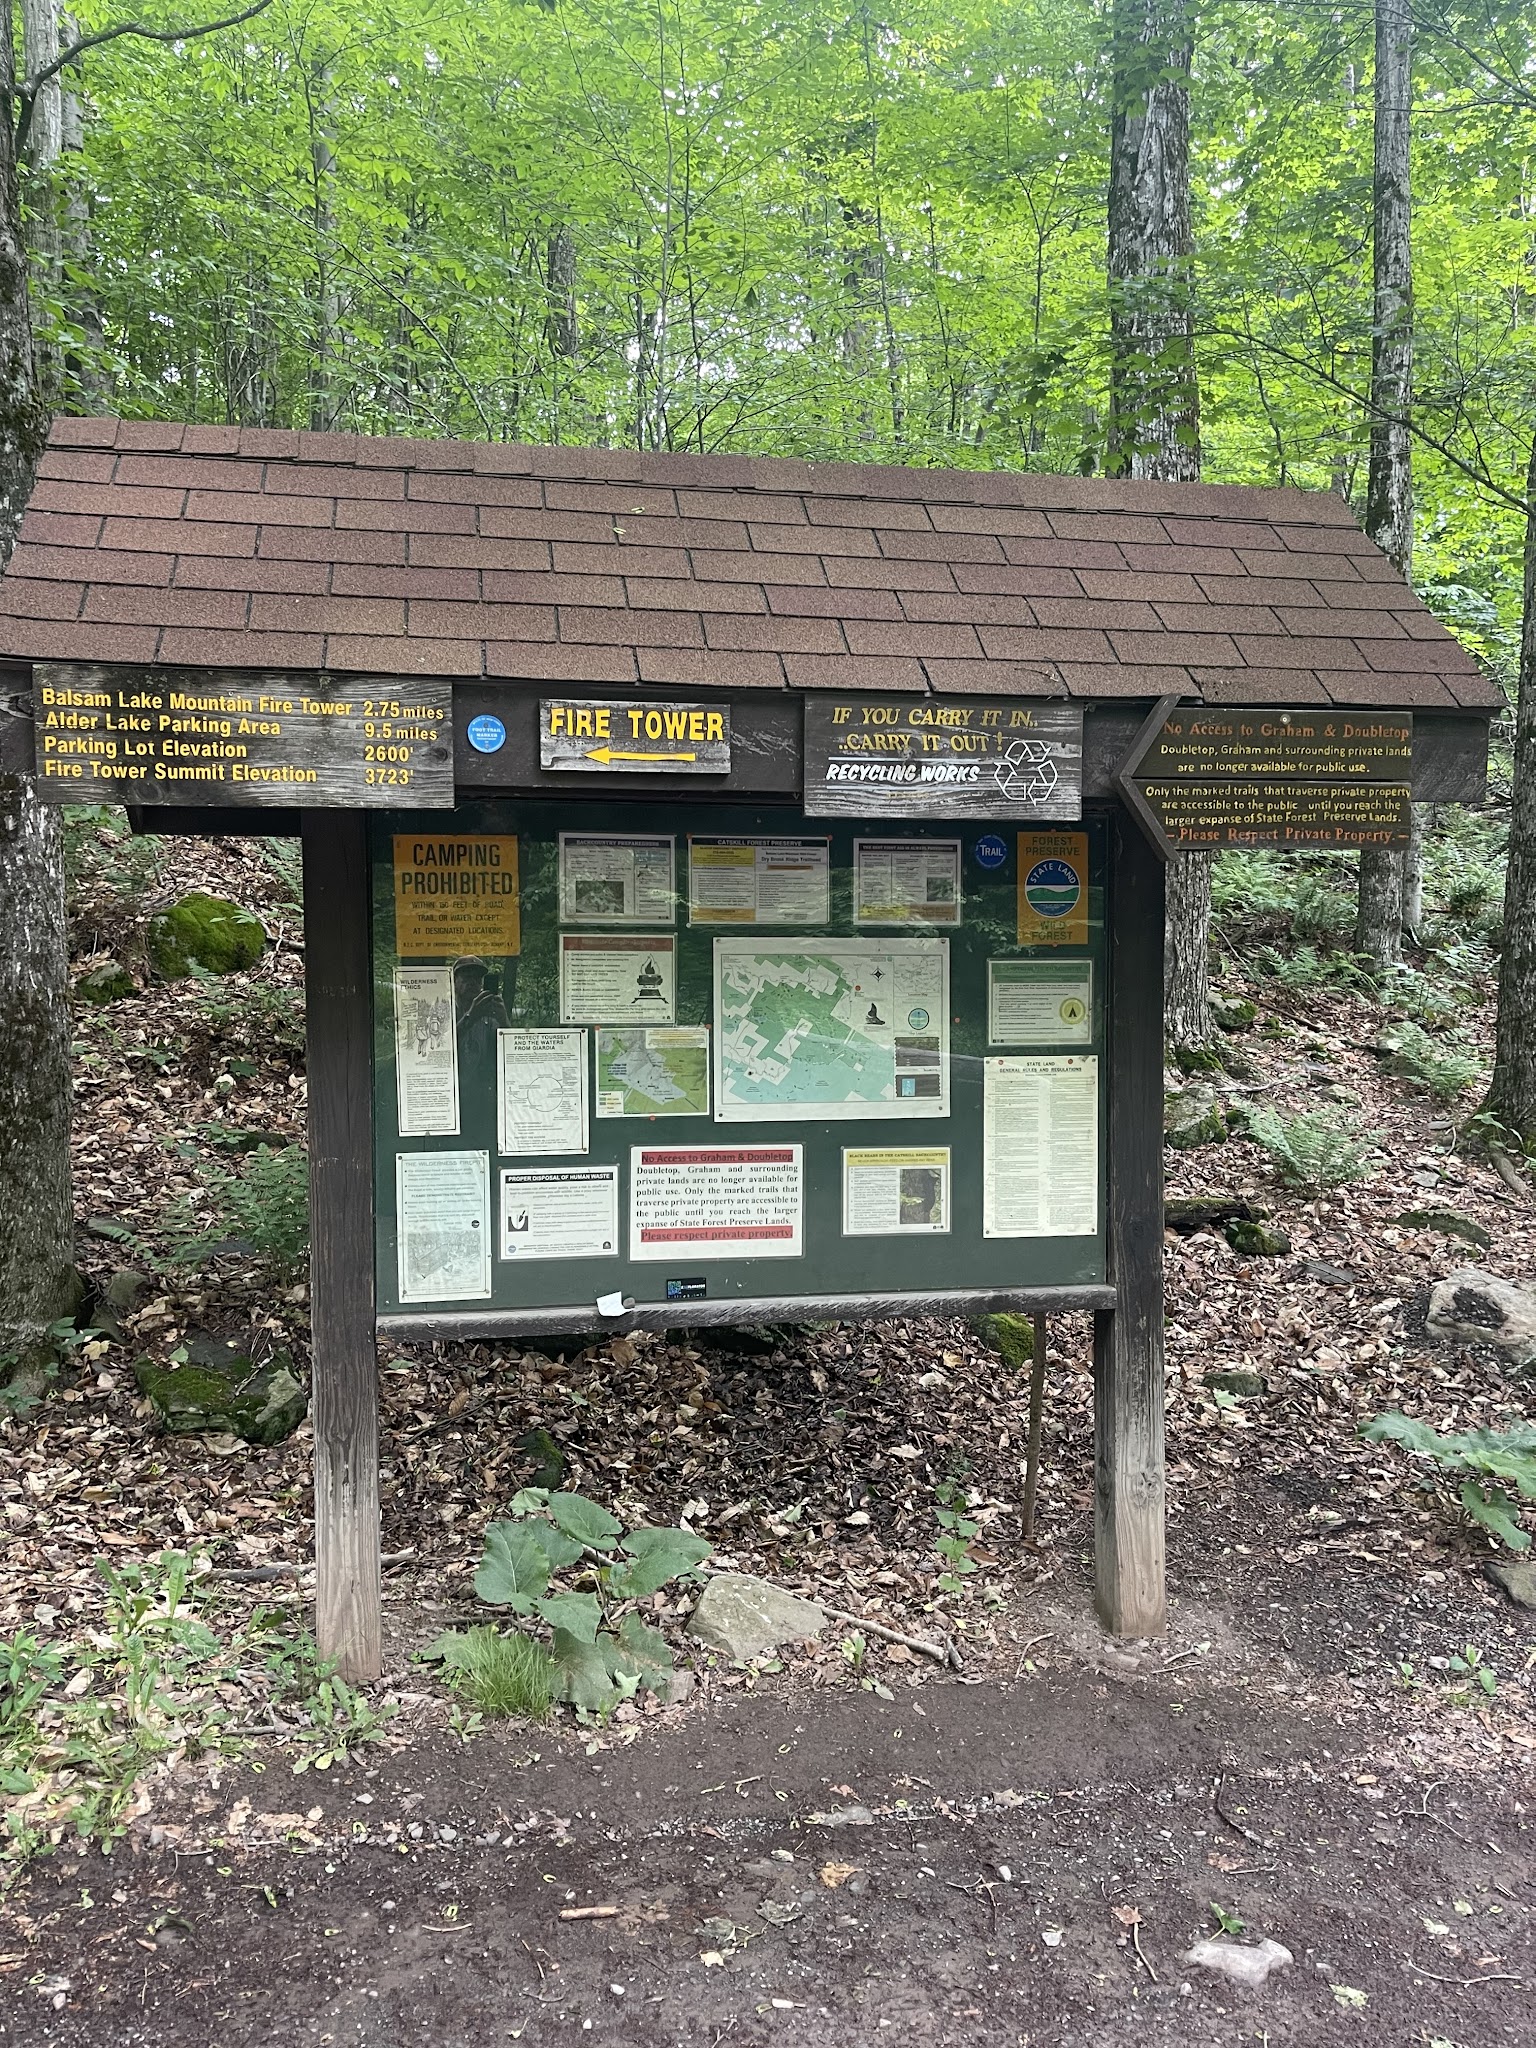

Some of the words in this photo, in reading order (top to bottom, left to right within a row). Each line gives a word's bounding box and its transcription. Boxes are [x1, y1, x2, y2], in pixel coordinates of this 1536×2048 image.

[42, 688, 111, 707] Balsam
[118, 691, 162, 709] Lake
[170, 693, 252, 713] Mountain
[259, 696, 292, 713] Fire
[301, 699, 352, 715] Tower
[364, 701, 400, 718] 2.75
[403, 706, 444, 720] miles
[832, 708, 852, 724] IF
[862, 708, 900, 724] YOU
[909, 708, 978, 726] CARRY
[982, 710, 1002, 726] IT
[45, 712, 97, 729] Alder
[106, 714, 151, 732] Lake
[159, 715, 231, 736] Parking
[238, 718, 280, 735] Area
[365, 722, 392, 739] 9.5
[396, 727, 438, 741] miles
[550, 708, 611, 738] FIRE
[628, 710, 724, 741] TOWER
[1164, 722, 1182, 734] No
[1190, 724, 1232, 736] Access
[1241, 724, 1253, 736] to
[1261, 724, 1314, 737] Graham
[1324, 725, 1336, 737] &
[1343, 724, 1409, 742] Doubletop
[45, 737, 117, 758] Parking
[124, 739, 155, 756] Lot
[162, 740, 247, 758] Elevation
[365, 746, 413, 762] 2600'
[922, 735, 940, 750] IT
[950, 736, 989, 751] OUT
[1161, 745, 1218, 756] Doubletop,
[1221, 743, 1260, 754] Graham
[1264, 745, 1282, 754] and
[1286, 746, 1346, 757] surrounding
[1348, 746, 1382, 757] private
[1386, 746, 1412, 756] lands
[45, 760, 83, 777] Fire
[90, 762, 147, 779] Tower
[154, 762, 225, 781] Summit
[232, 765, 317, 783] Elevation
[365, 768, 414, 785] 3723'
[826, 764, 916, 780] RECYCLING
[921, 766, 980, 782] WORKS
[1178, 763, 1194, 772] are
[1216, 762, 1248, 772] longer
[1251, 762, 1296, 772] available
[1298, 762, 1312, 772] for
[1316, 763, 1346, 773] public
[1348, 764, 1370, 772] use.
[1146, 786, 1170, 798] Only
[1172, 786, 1189, 796] the
[1192, 786, 1231, 796] marked
[1234, 785, 1258, 796] trails
[1264, 786, 1284, 796] that
[1288, 787, 1328, 796] traverse
[1331, 787, 1366, 798] private
[1368, 788, 1410, 798] property
[1181, 800, 1232, 810] accessible
[1234, 802, 1244, 810] to
[1248, 800, 1264, 810] the
[1268, 800, 1298, 812] public
[1308, 801, 1331, 810] until
[1334, 803, 1352, 812] you
[1354, 802, 1382, 810] reach
[1384, 801, 1400, 810] the
[1165, 816, 1195, 826] larger
[1199, 816, 1242, 825] expanse
[1244, 813, 1254, 822] of
[1257, 813, 1283, 823] State
[1286, 813, 1316, 822] Forest
[1324, 812, 1366, 822] Preserve
[1369, 812, 1401, 822] Lands.
[1032, 837, 1073, 845] FOREST
[1180, 828, 1220, 841] Please
[1228, 829, 1278, 843] Respect
[1286, 828, 1331, 840] Private
[413, 844, 500, 866] CAMPING
[980, 845, 1003, 856] TRAIL
[1026, 847, 1080, 855] PRESERVE
[1031, 863, 1053, 883] STATE
[1058, 864, 1076, 883] LAND
[402, 872, 512, 895] PROHIBITED
[1032, 932, 1072, 940] FOREST
[642, 1154, 654, 1163] No
[657, 1153, 686, 1162] Access
[688, 1154, 698, 1162] to
[700, 1154, 735, 1162] Graham
[747, 1152, 793, 1162] Doubletop
[750, 1165, 798, 1174] surrounding
[637, 1177, 664, 1186] private
[721, 1176, 746, 1184] longer
[749, 1175, 783, 1183] available
[637, 1188, 661, 1197] public
[685, 1187, 703, 1195] Only
[725, 1186, 754, 1194] marked
[637, 1220, 667, 1229] expanse
[670, 1219, 679, 1227] of
[680, 1219, 700, 1227] State
[729, 1218, 762, 1226] Preserve
[765, 1217, 791, 1225] Lands.
[641, 1231, 671, 1240] Please
[674, 1231, 708, 1240] respect
[712, 1229, 745, 1240] private
[749, 1229, 793, 1239] property.
